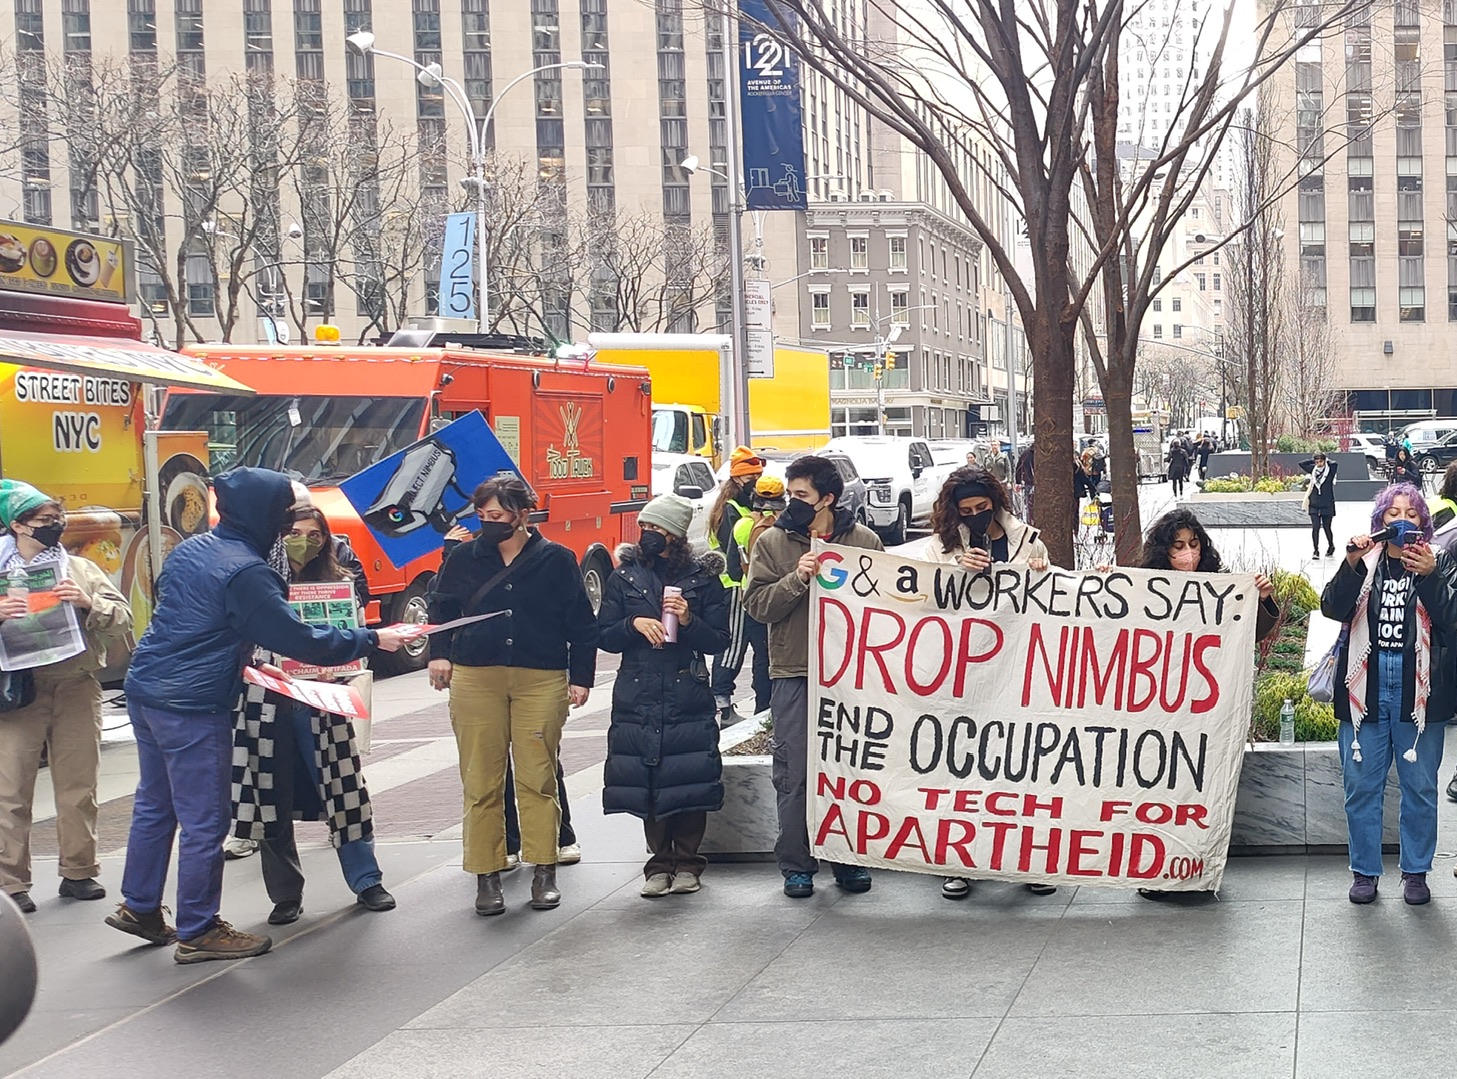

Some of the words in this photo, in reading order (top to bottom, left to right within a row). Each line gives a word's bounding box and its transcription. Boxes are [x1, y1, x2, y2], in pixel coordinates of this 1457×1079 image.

[16, 373, 81, 402] STREET
[85, 378, 131, 405] BITES
[54, 414, 100, 450] NYC
[420, 449, 442, 478] NIMBUS
[933, 567, 1133, 619] WORKERS
[1143, 577, 1244, 626] SAY:
[818, 596, 1004, 698] DROP
[1021, 622, 1221, 714] NIMBUS
[817, 696, 894, 740] END
[817, 731, 889, 770] THE
[909, 713, 1208, 793] OCCUPATION
[816, 772, 882, 806] NO
[917, 787, 1064, 819] TECH
[1099, 800, 1210, 830] FOR
